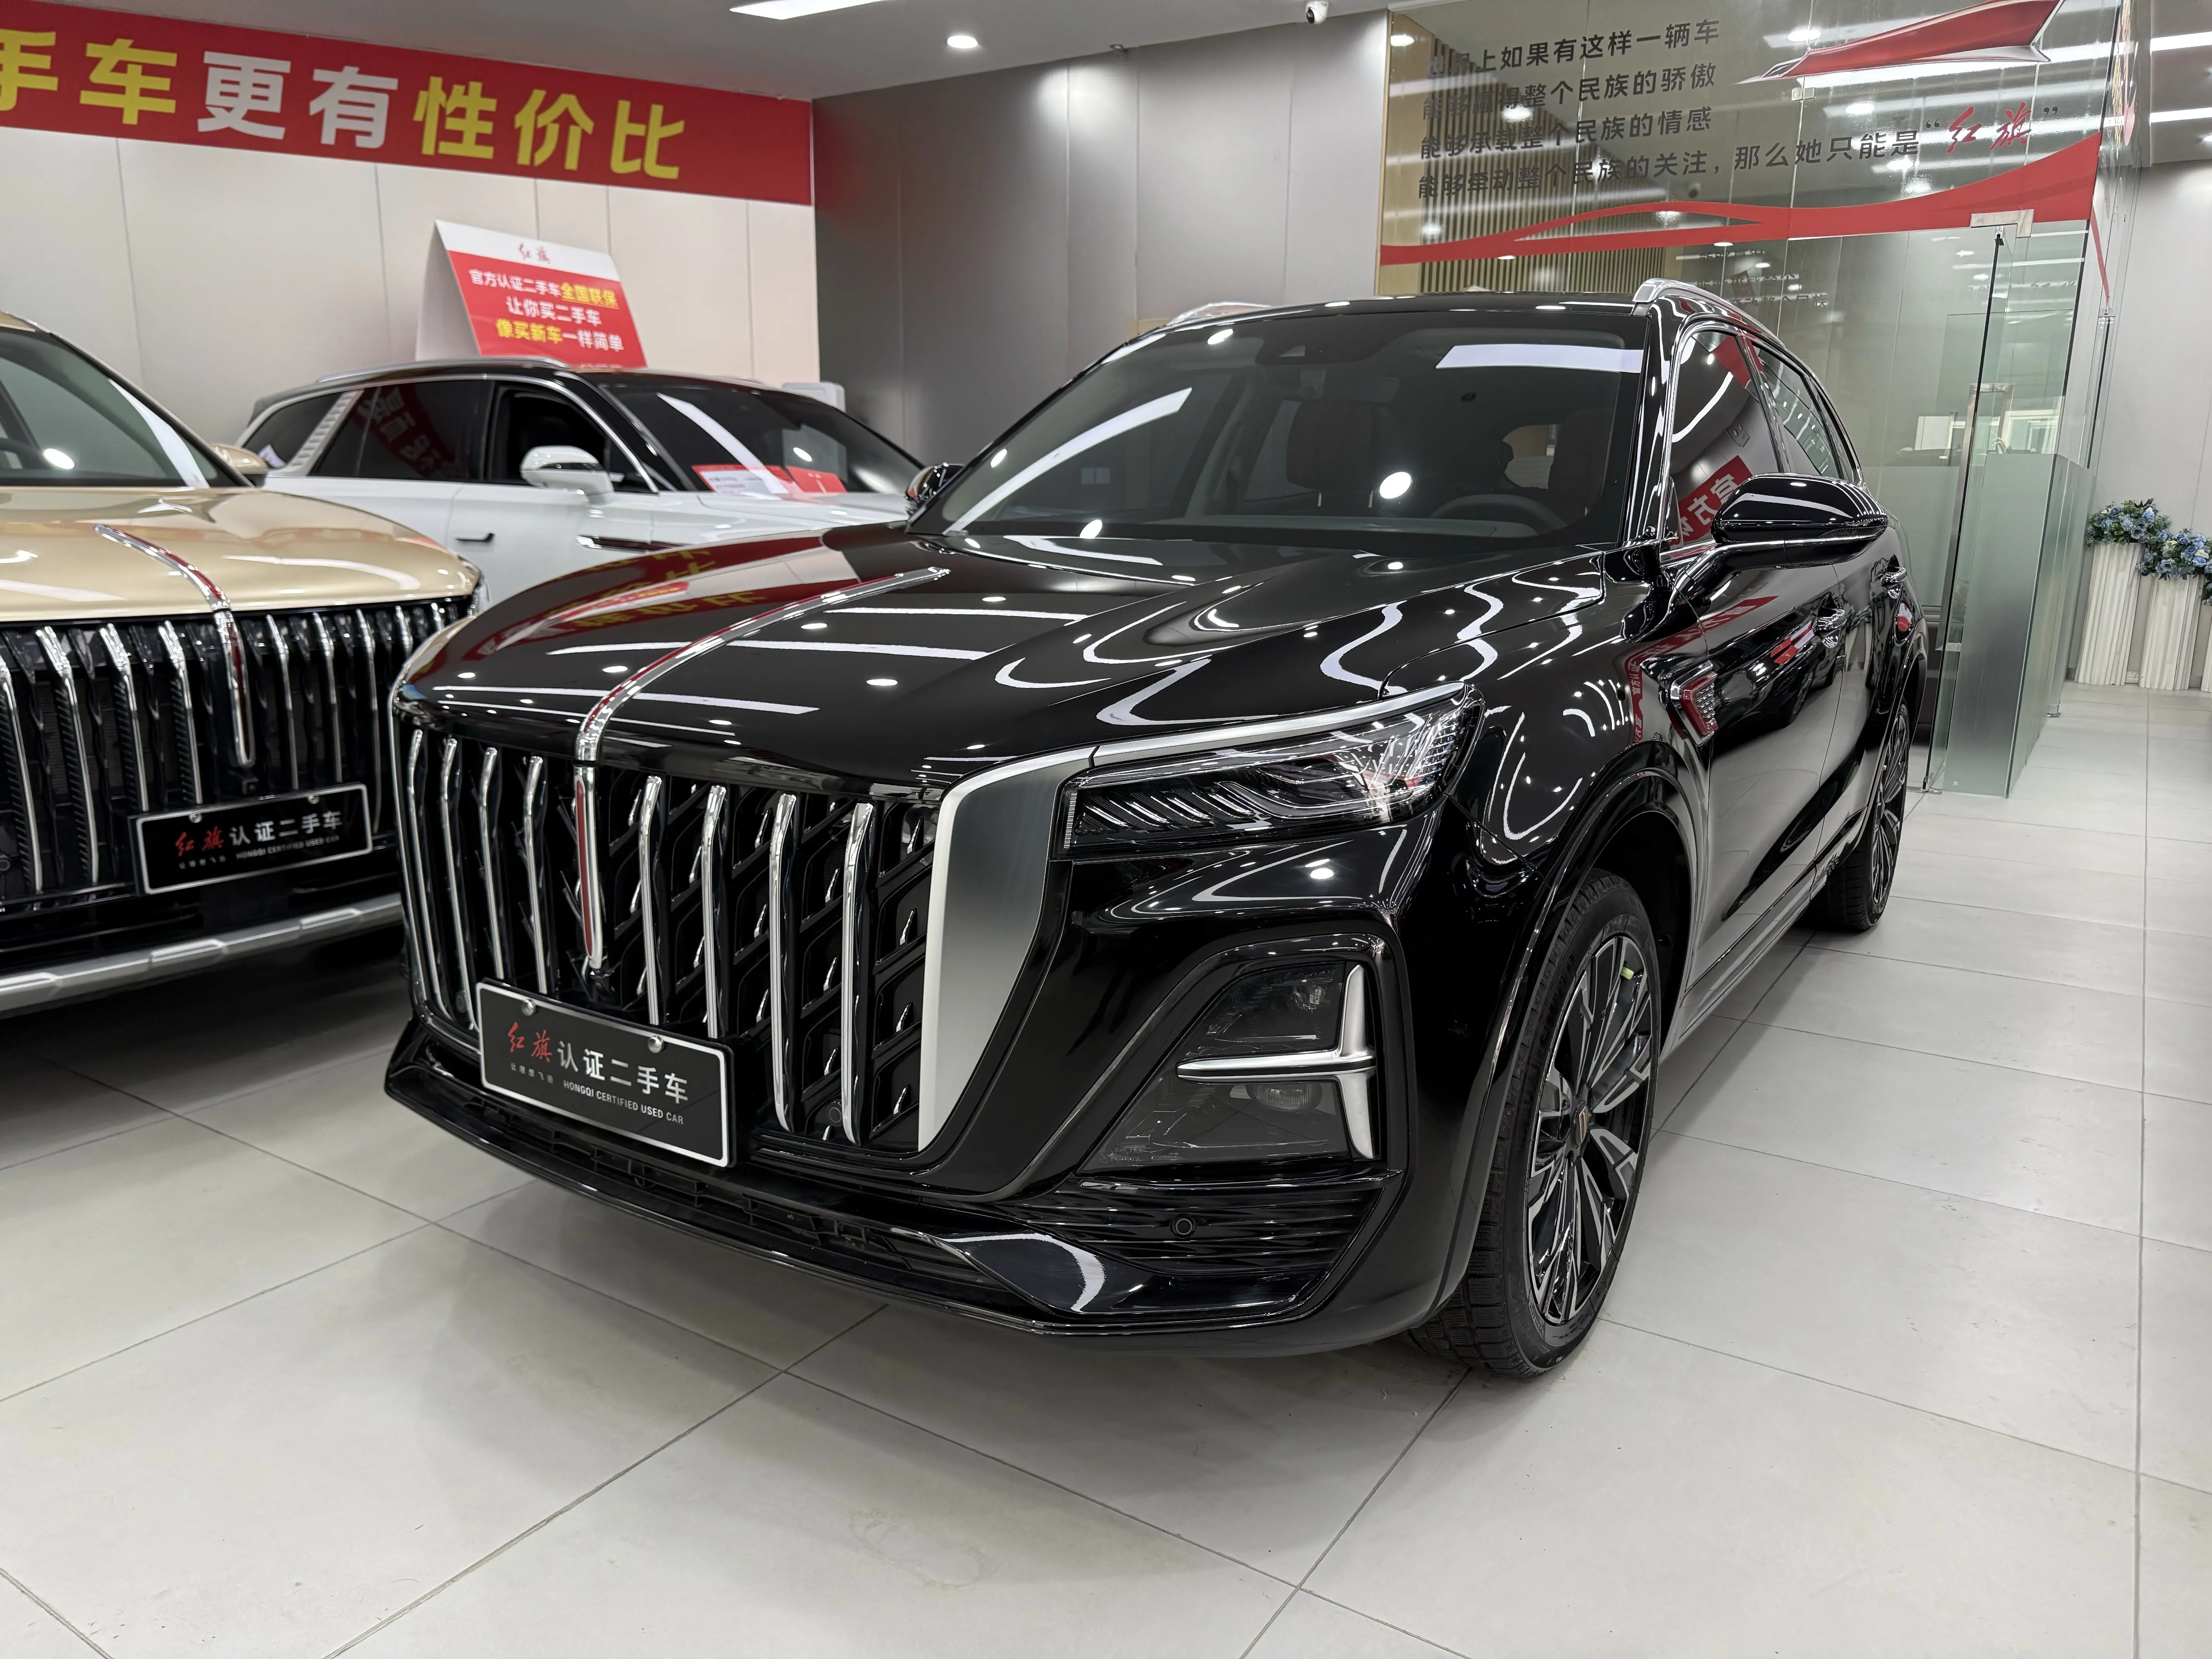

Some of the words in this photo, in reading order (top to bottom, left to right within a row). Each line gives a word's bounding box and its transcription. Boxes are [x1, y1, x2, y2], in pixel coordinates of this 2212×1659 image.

[1421, 106, 1712, 160] 能够承载整个民族的情感
[506, 296, 602, 326] 让你买二手车
[496, 318, 624, 352] 像买新车一样简单
[563, 1080, 594, 1097] HONGQI
[596, 1091, 638, 1111] CERTIFIED
[641, 1104, 663, 1119] USED
[666, 1112, 683, 1125] CAR
